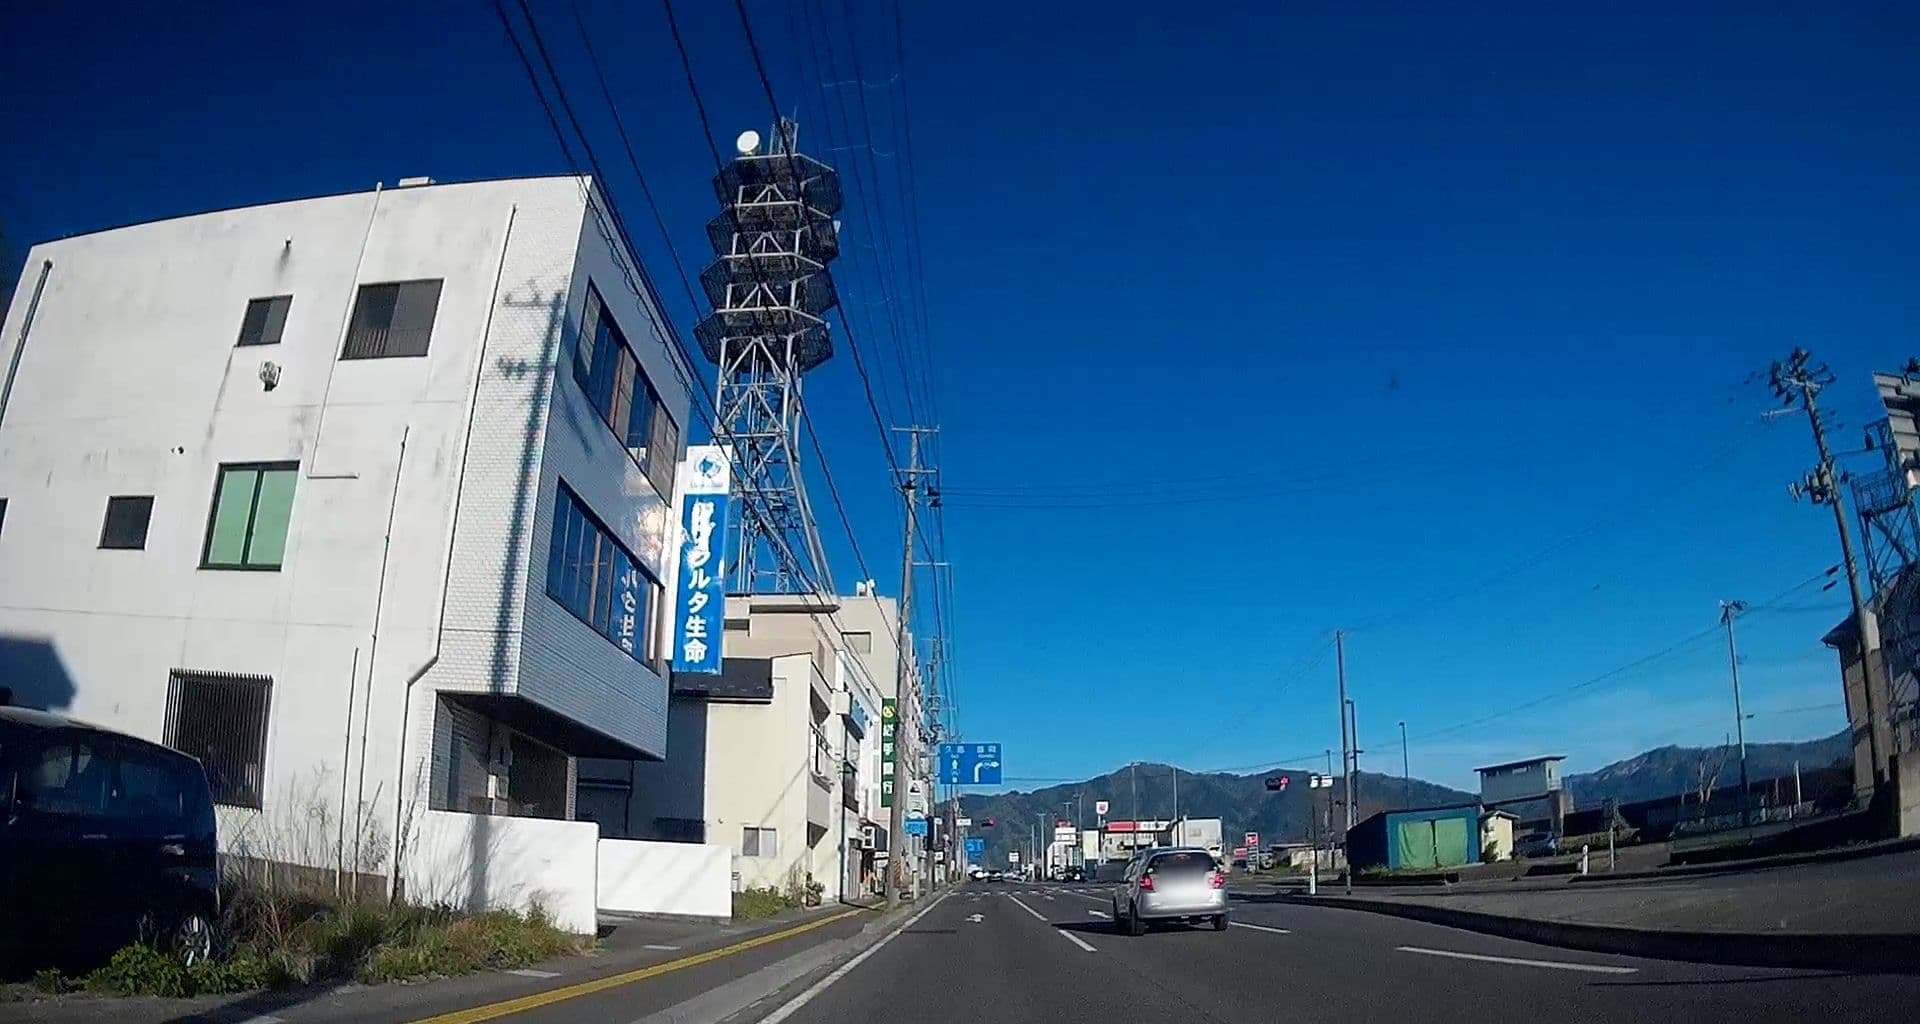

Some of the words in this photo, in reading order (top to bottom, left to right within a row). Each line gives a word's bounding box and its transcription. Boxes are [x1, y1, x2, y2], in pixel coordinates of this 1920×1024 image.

[683, 500, 717, 664] ラルタ生命
